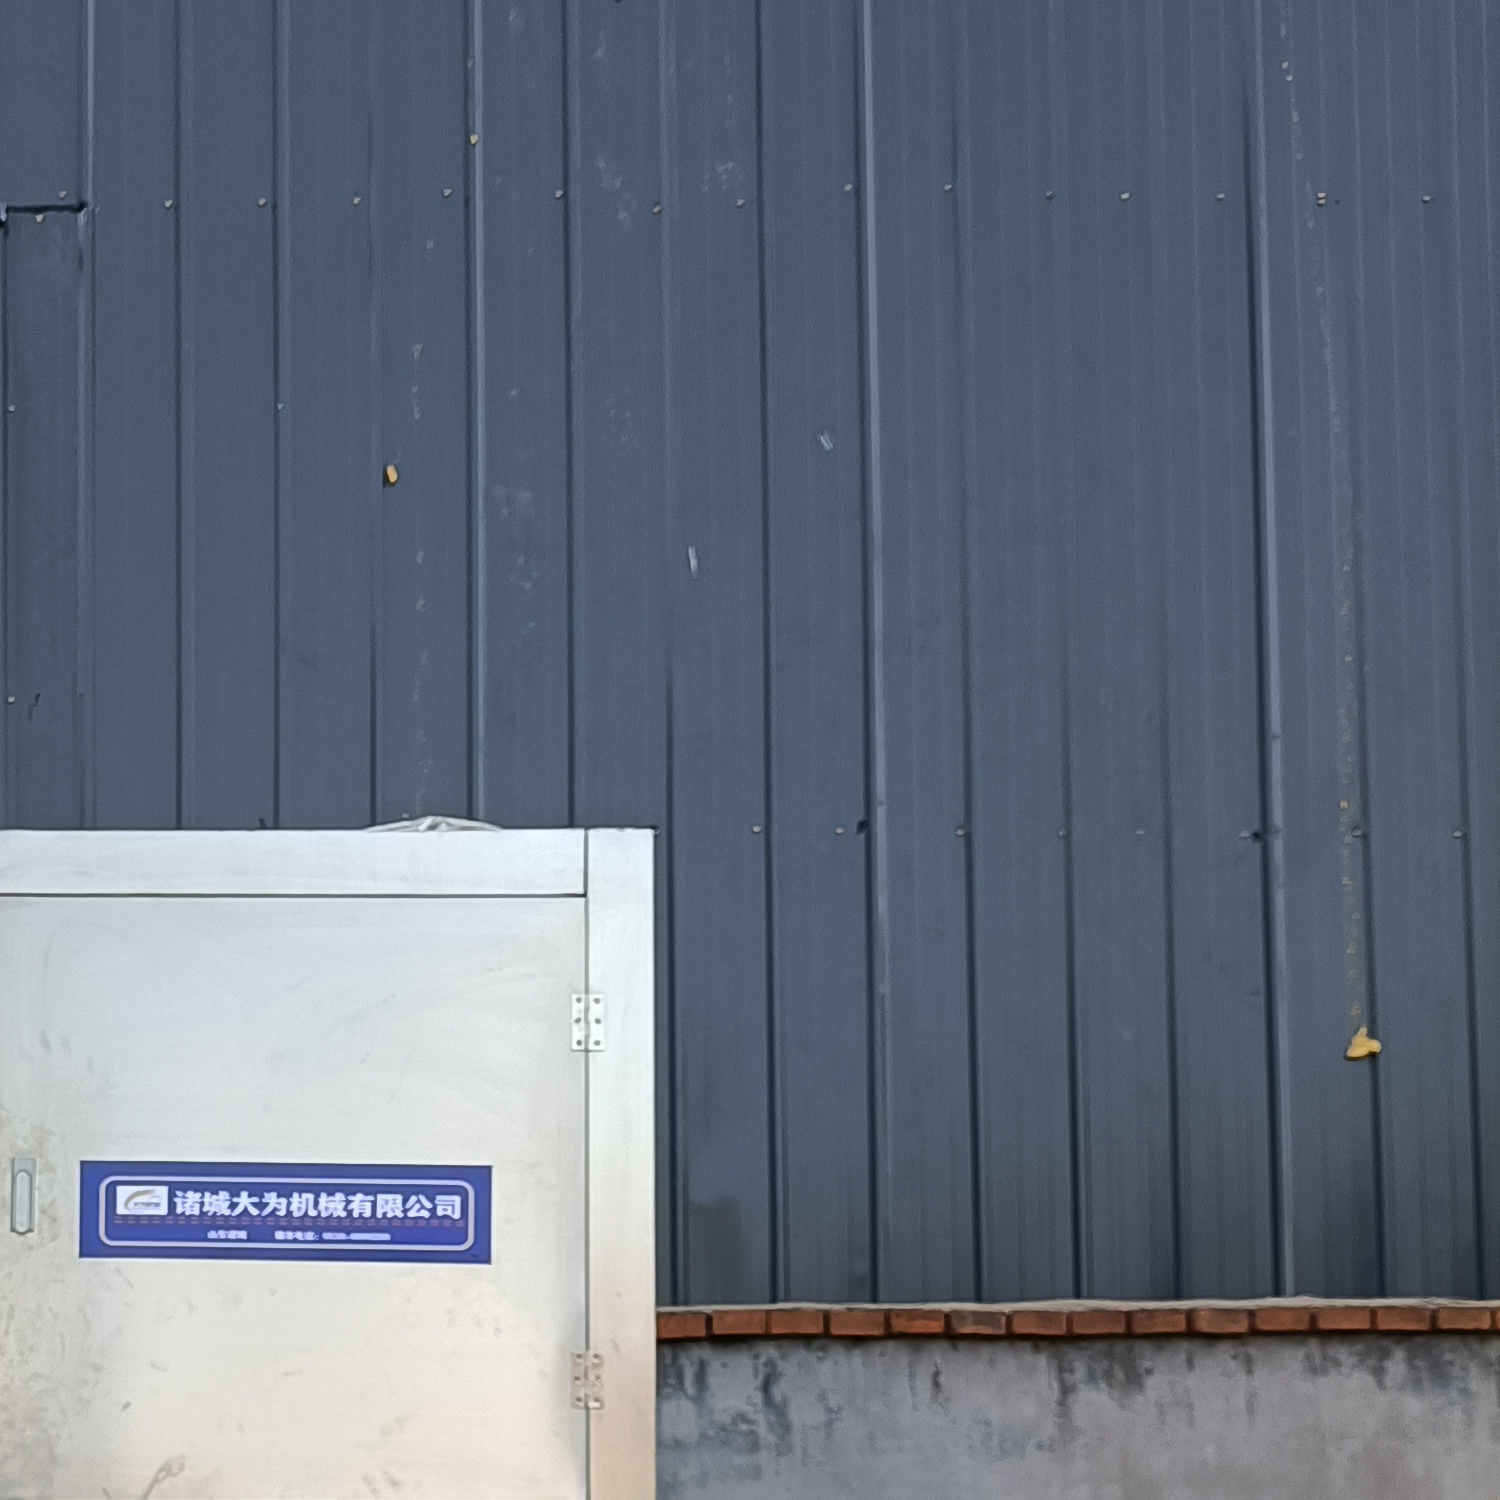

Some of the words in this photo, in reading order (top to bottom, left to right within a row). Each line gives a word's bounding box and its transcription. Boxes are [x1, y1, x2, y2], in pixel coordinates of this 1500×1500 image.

[173, 1190, 463, 1220] 诸城大为机械有限公司
